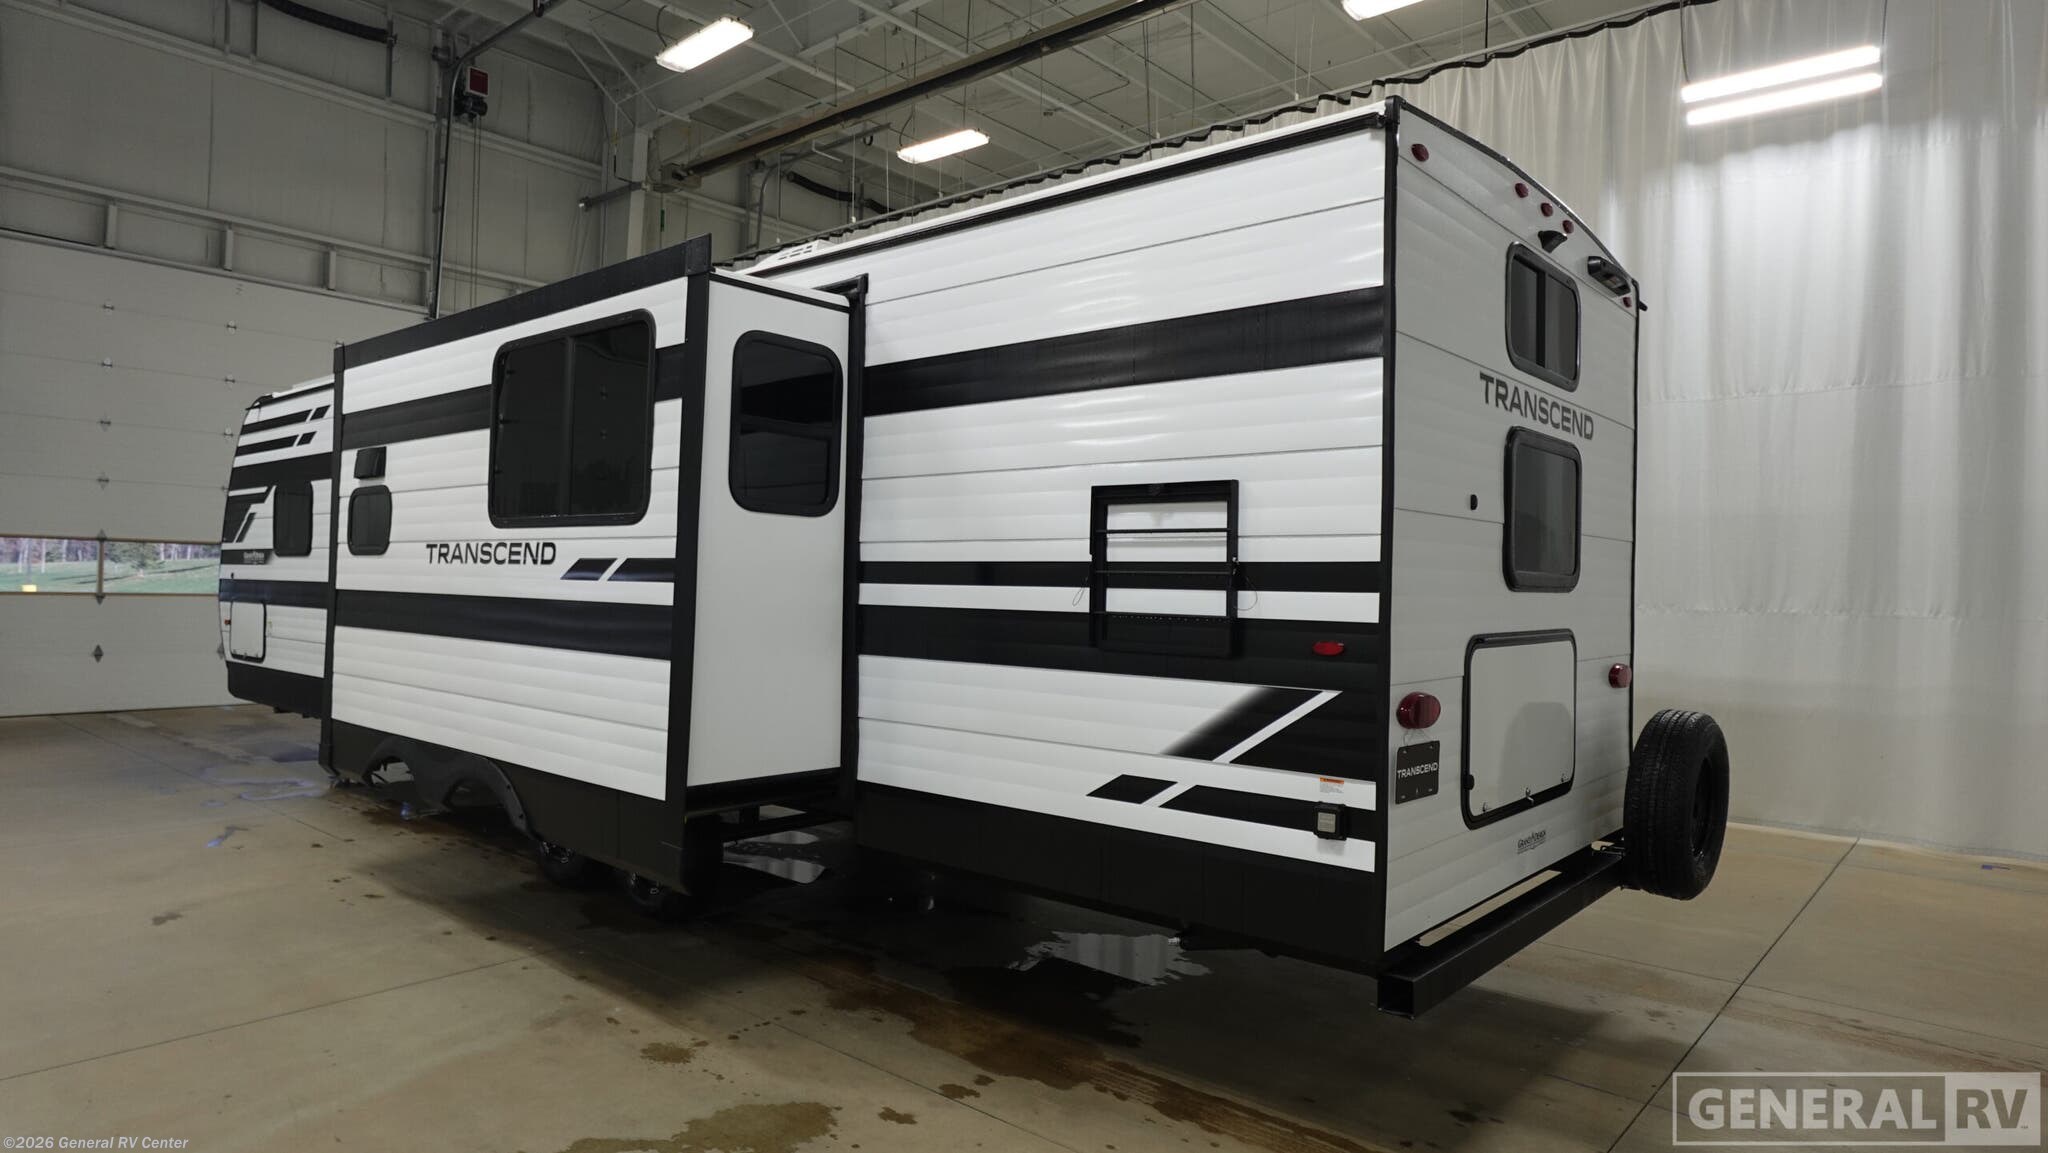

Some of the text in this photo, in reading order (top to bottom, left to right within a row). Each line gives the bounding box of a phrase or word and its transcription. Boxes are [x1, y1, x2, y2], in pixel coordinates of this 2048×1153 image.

[1480, 372, 1594, 440] TRANSCEND
[426, 542, 557, 565] TRANSCEND
[1397, 762, 1439, 779] TRANSCEND
